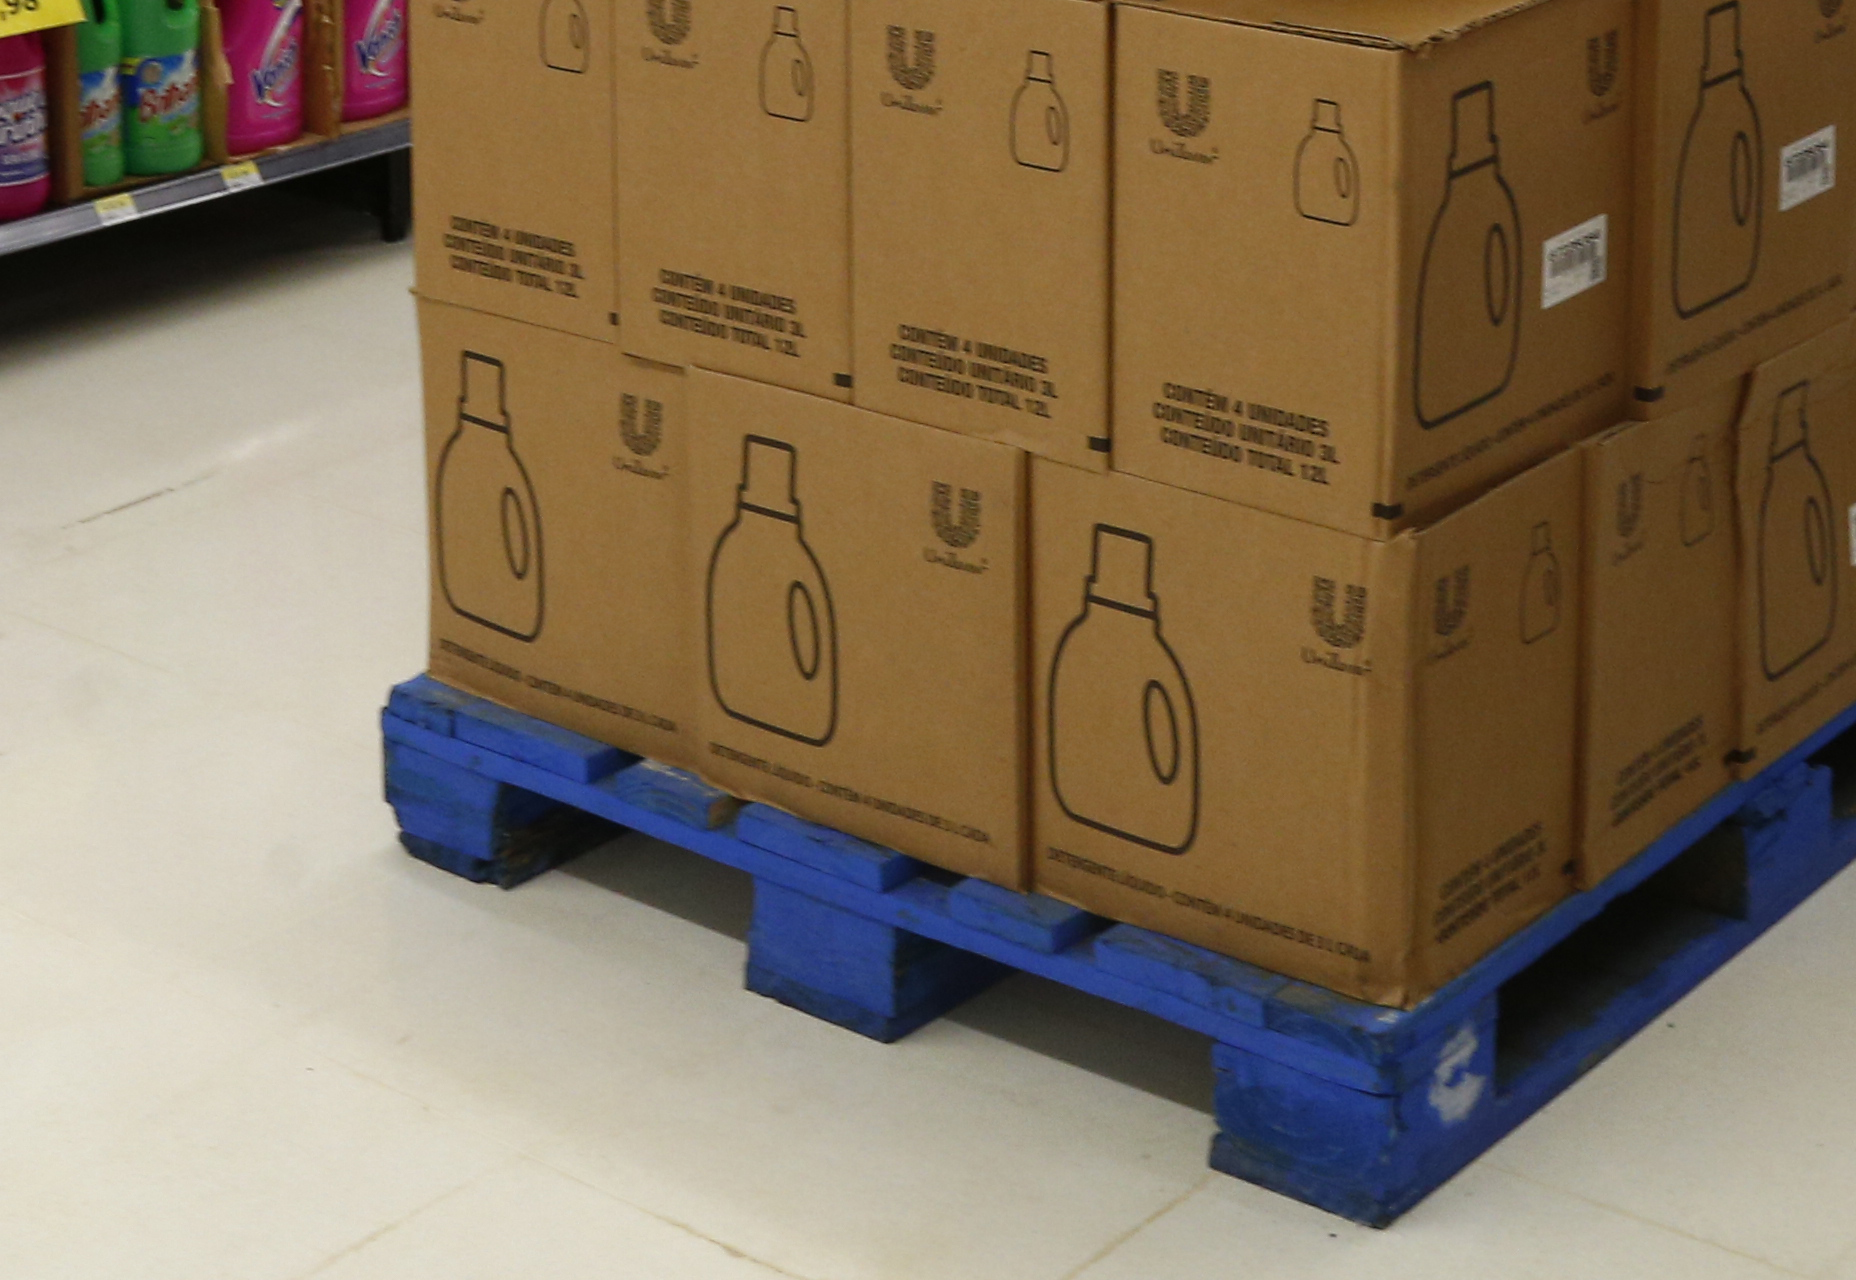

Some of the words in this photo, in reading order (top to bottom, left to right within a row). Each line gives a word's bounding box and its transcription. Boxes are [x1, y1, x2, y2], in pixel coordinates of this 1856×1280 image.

[1162, 382, 1229, 414] CONTÉM
[1233, 400, 1244, 415] 4
[1247, 401, 1330, 438] UNIDADES
[1247, 448, 1294, 477] TOTAL
[1299, 463, 1331, 486] 12L
